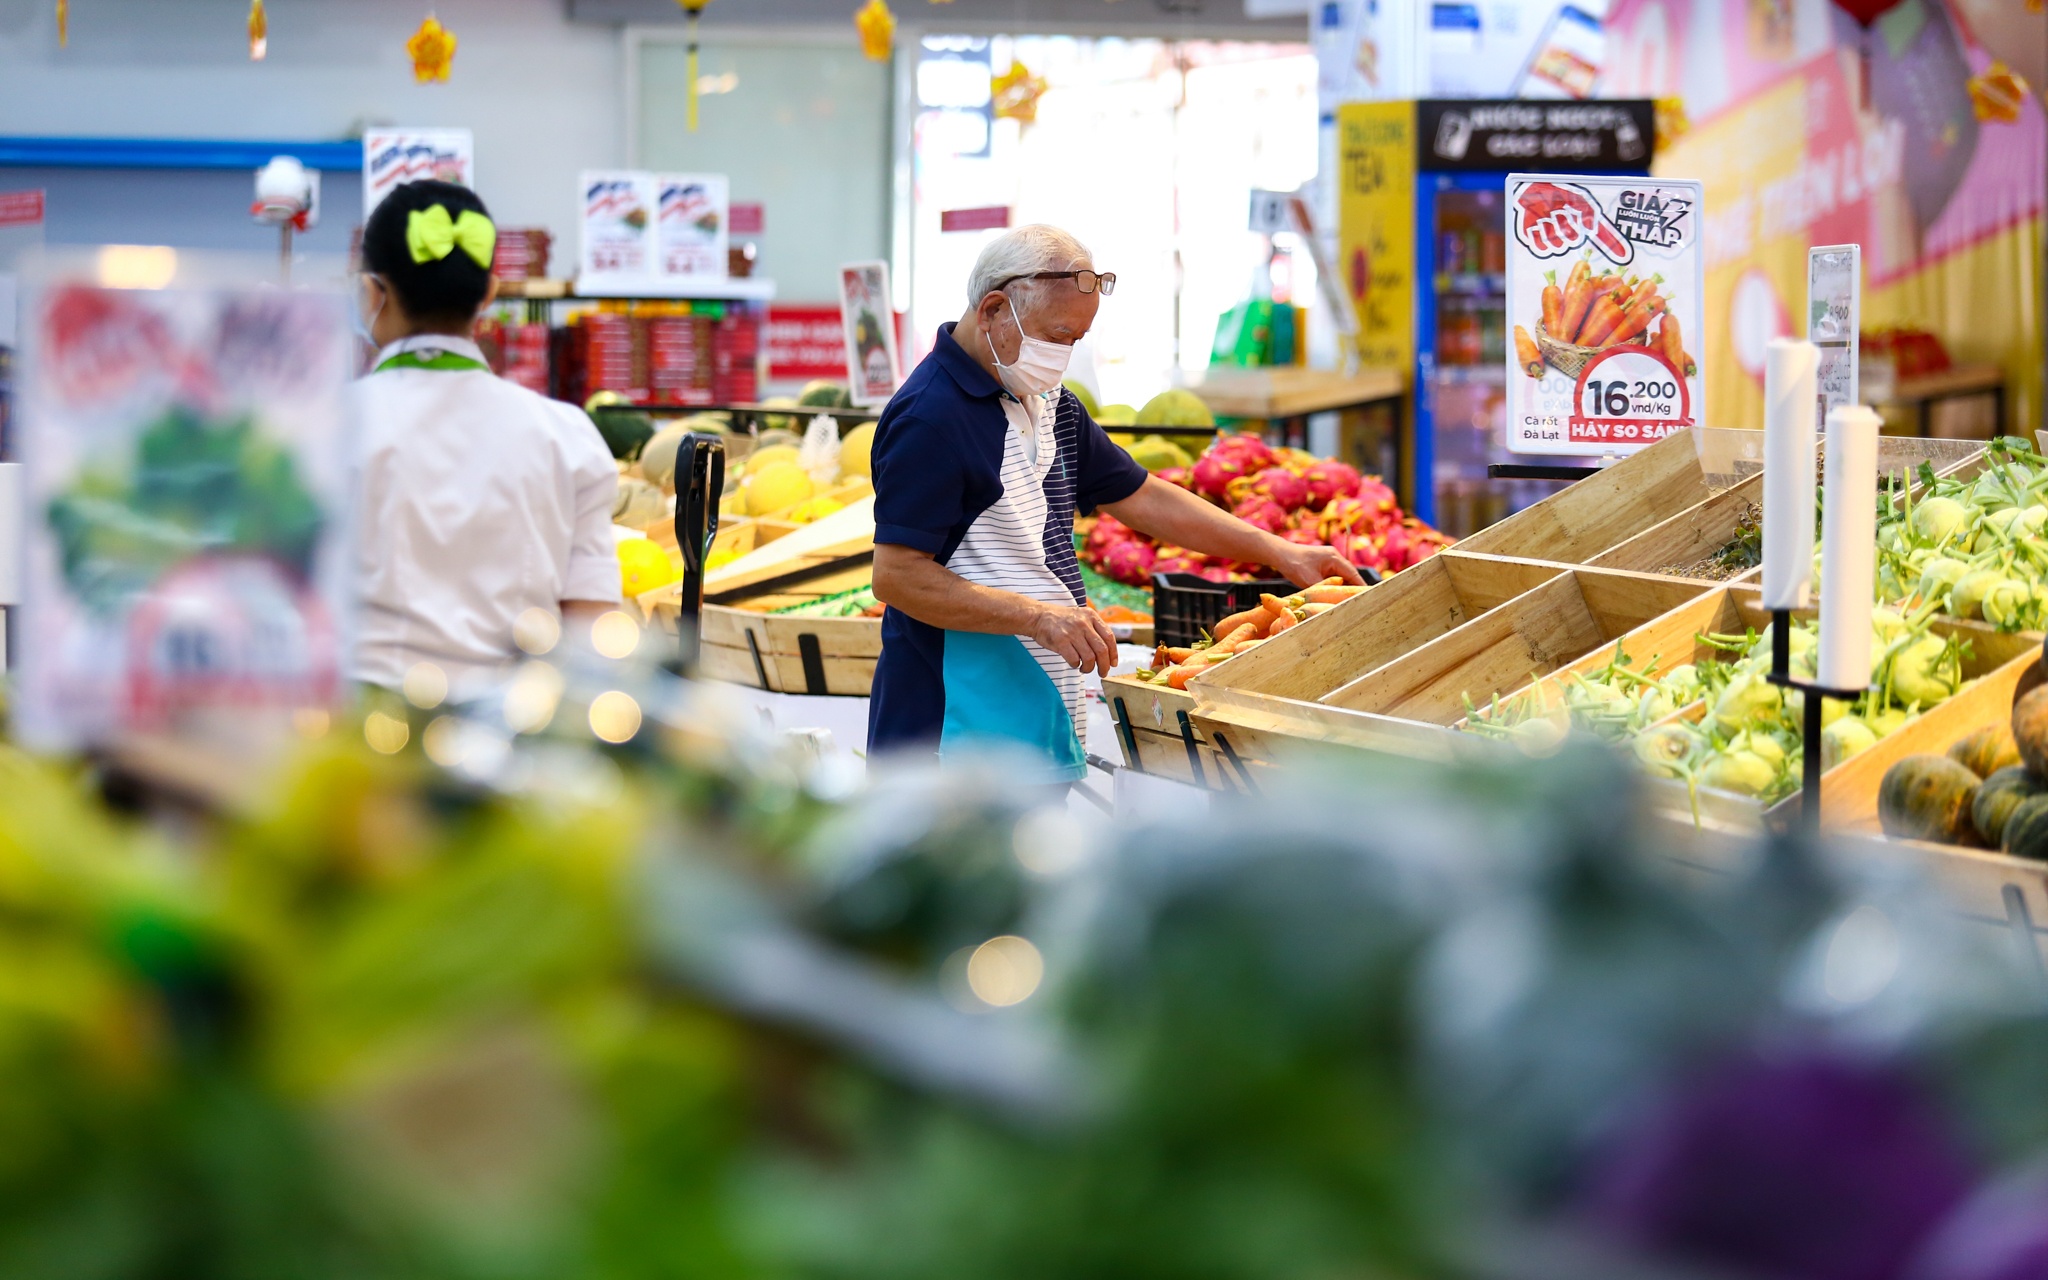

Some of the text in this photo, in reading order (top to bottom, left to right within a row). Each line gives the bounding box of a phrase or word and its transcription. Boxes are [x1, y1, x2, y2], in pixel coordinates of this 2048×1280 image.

[1619, 188, 1661, 212] GIÁ
[1618, 208, 1661, 222] LUÔN LUÔN
[1631, 402, 1671, 415] vnd/Kg
[1525, 415, 1558, 426] Cà rốt
[1524, 429, 1560, 442] Đà Lạt
[1571, 421, 1688, 439] HÃY SO SÁN
